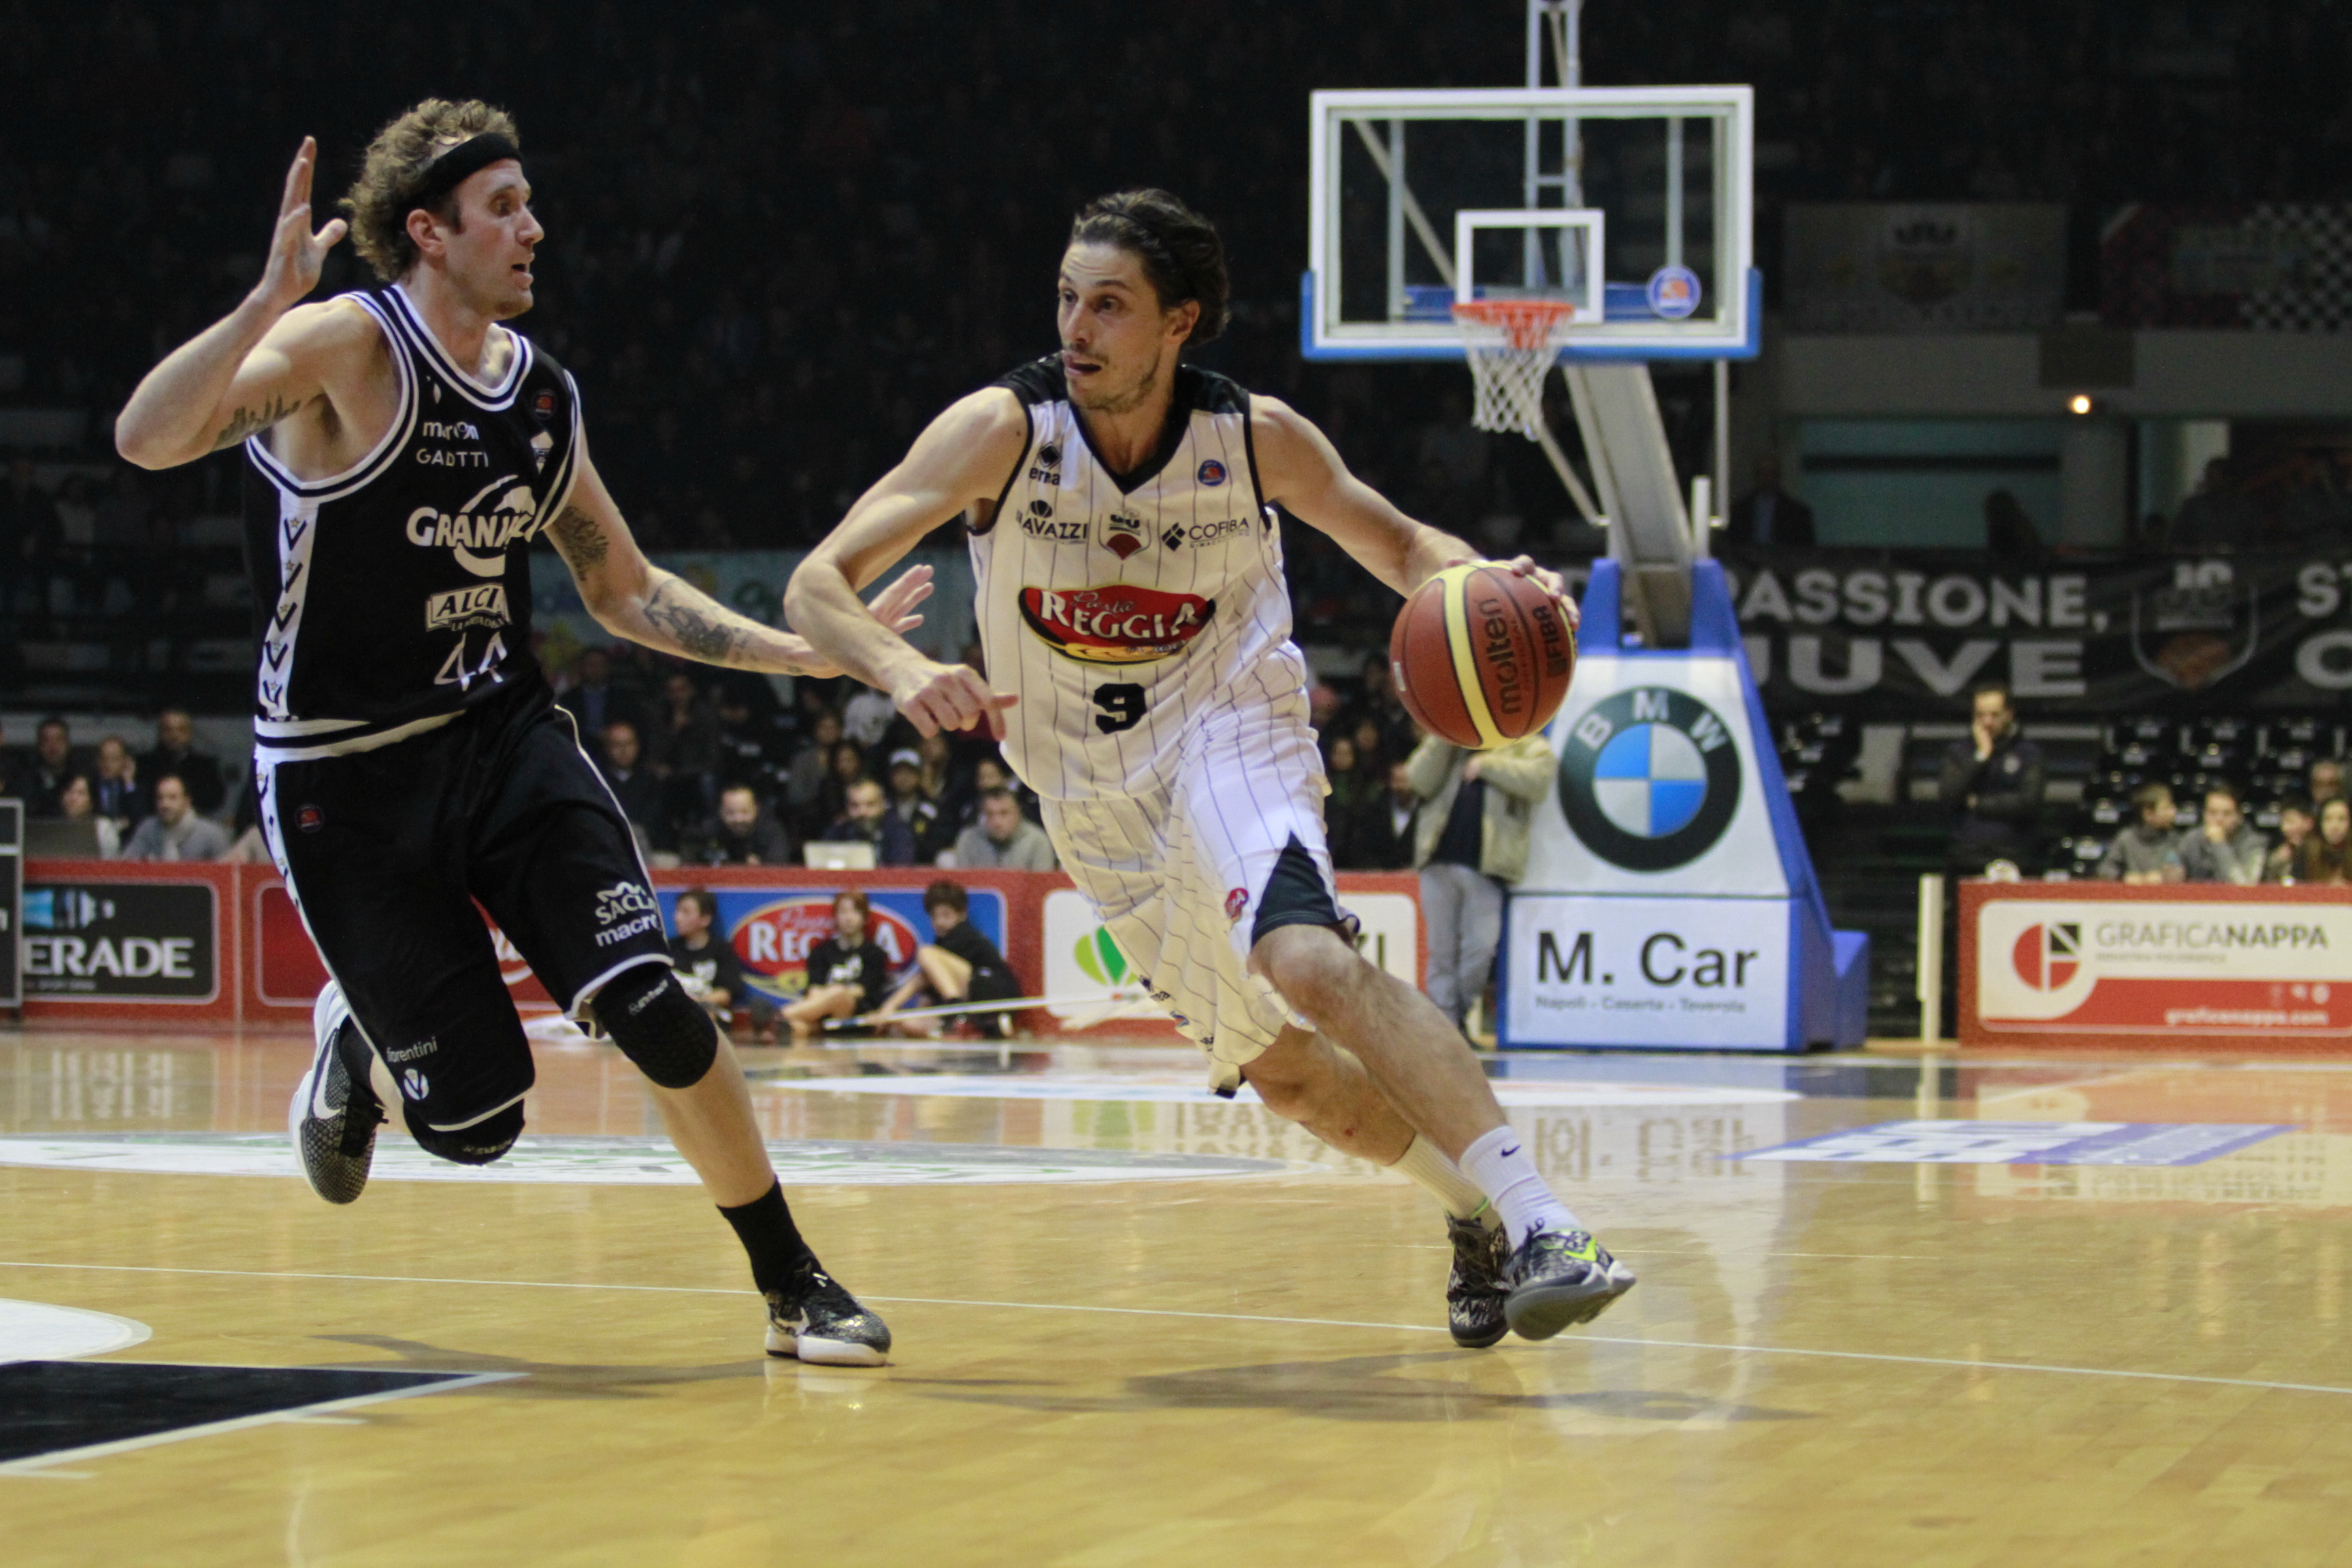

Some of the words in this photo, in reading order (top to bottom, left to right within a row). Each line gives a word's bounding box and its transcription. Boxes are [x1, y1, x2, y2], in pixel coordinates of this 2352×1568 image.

[1041, 591, 1199, 638] REGGIA
[1478, 598, 1522, 713] molten
[1093, 683, 1147, 735] 9
[1576, 690, 1727, 753] BMW
[1537, 930, 1615, 984] M.
[1640, 931, 1759, 988] Car
[2095, 921, 2330, 949] GRAFICANAPPA
